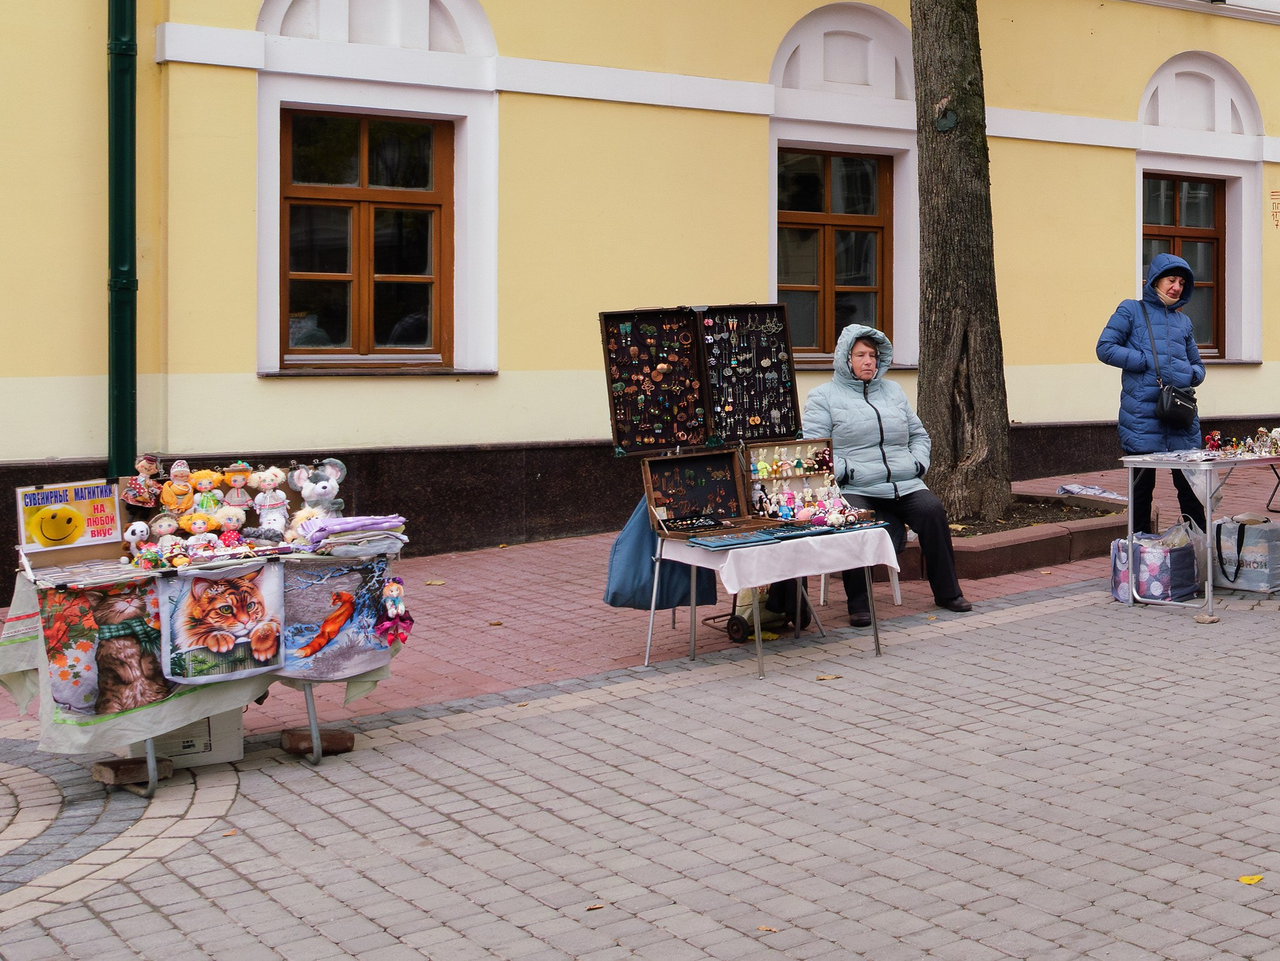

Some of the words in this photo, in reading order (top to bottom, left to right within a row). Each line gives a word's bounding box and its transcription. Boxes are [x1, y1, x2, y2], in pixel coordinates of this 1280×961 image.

[23, 489, 69, 507] СУВЕНИРНЫЕ
[92, 503, 106, 514] НА
[86, 513, 115, 528] ЛЮБОЙ
[90, 527, 113, 538] ВКУС
